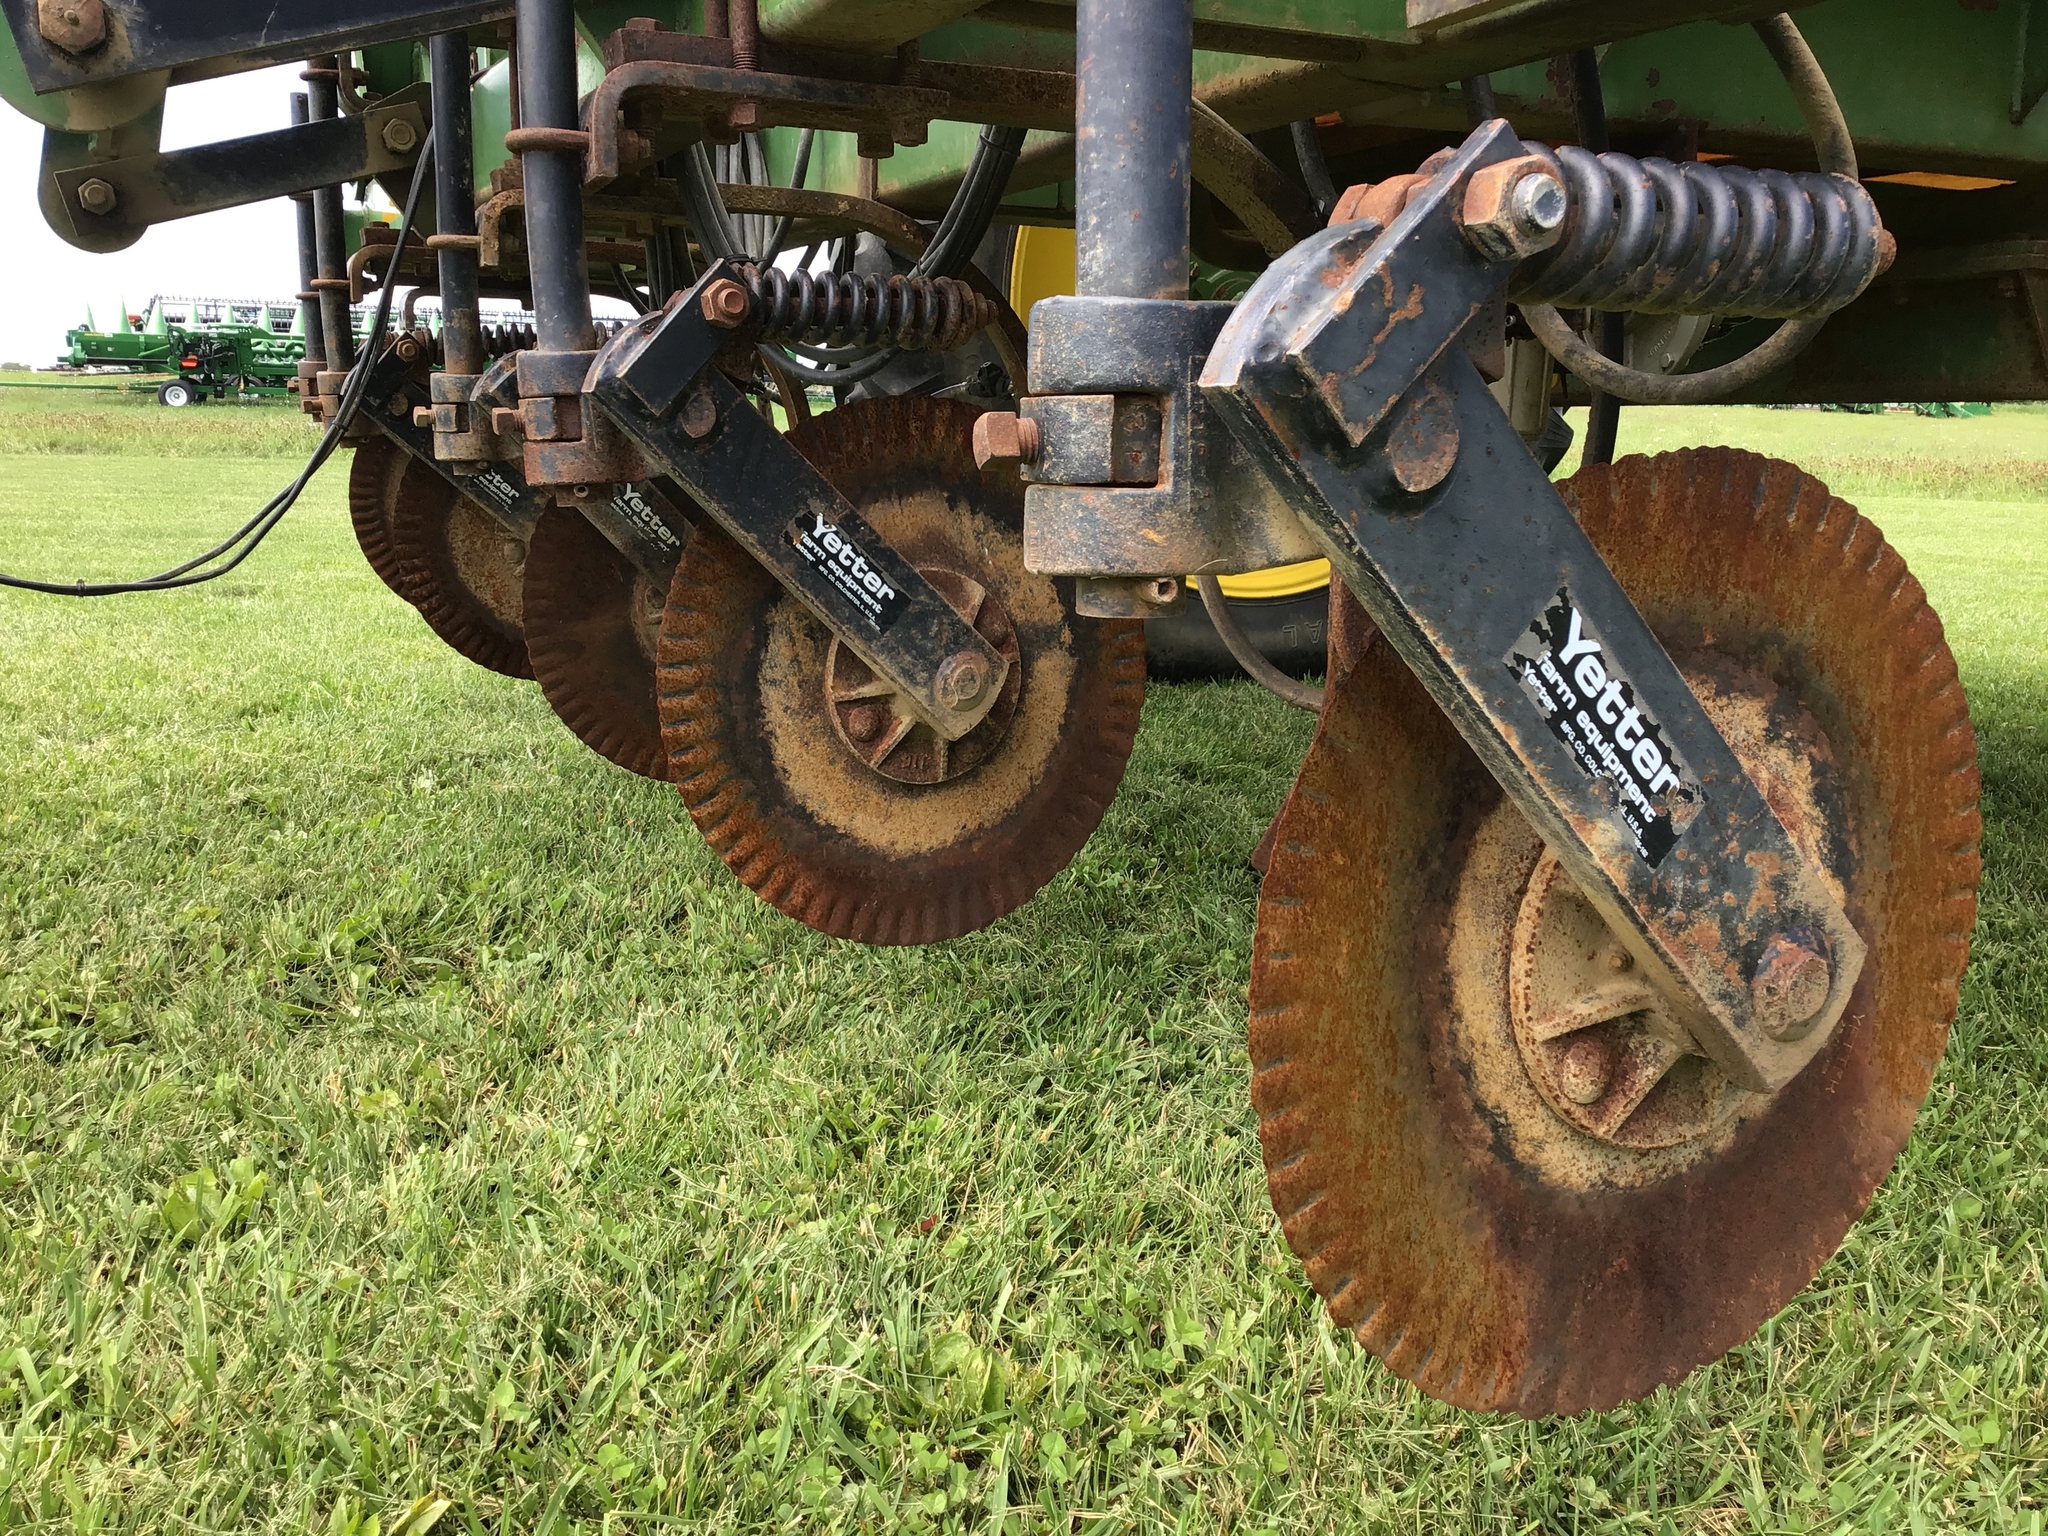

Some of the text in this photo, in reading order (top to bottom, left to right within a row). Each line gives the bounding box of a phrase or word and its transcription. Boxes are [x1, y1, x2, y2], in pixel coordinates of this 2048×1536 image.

[623, 482, 680, 547] Yetter
[812, 512, 896, 600] Yetter
[827, 559, 883, 613] equipment
[1535, 650, 1657, 823] farm equipment
[1558, 606, 1681, 793] Yetter
[1560, 720, 1577, 743] MFG.
